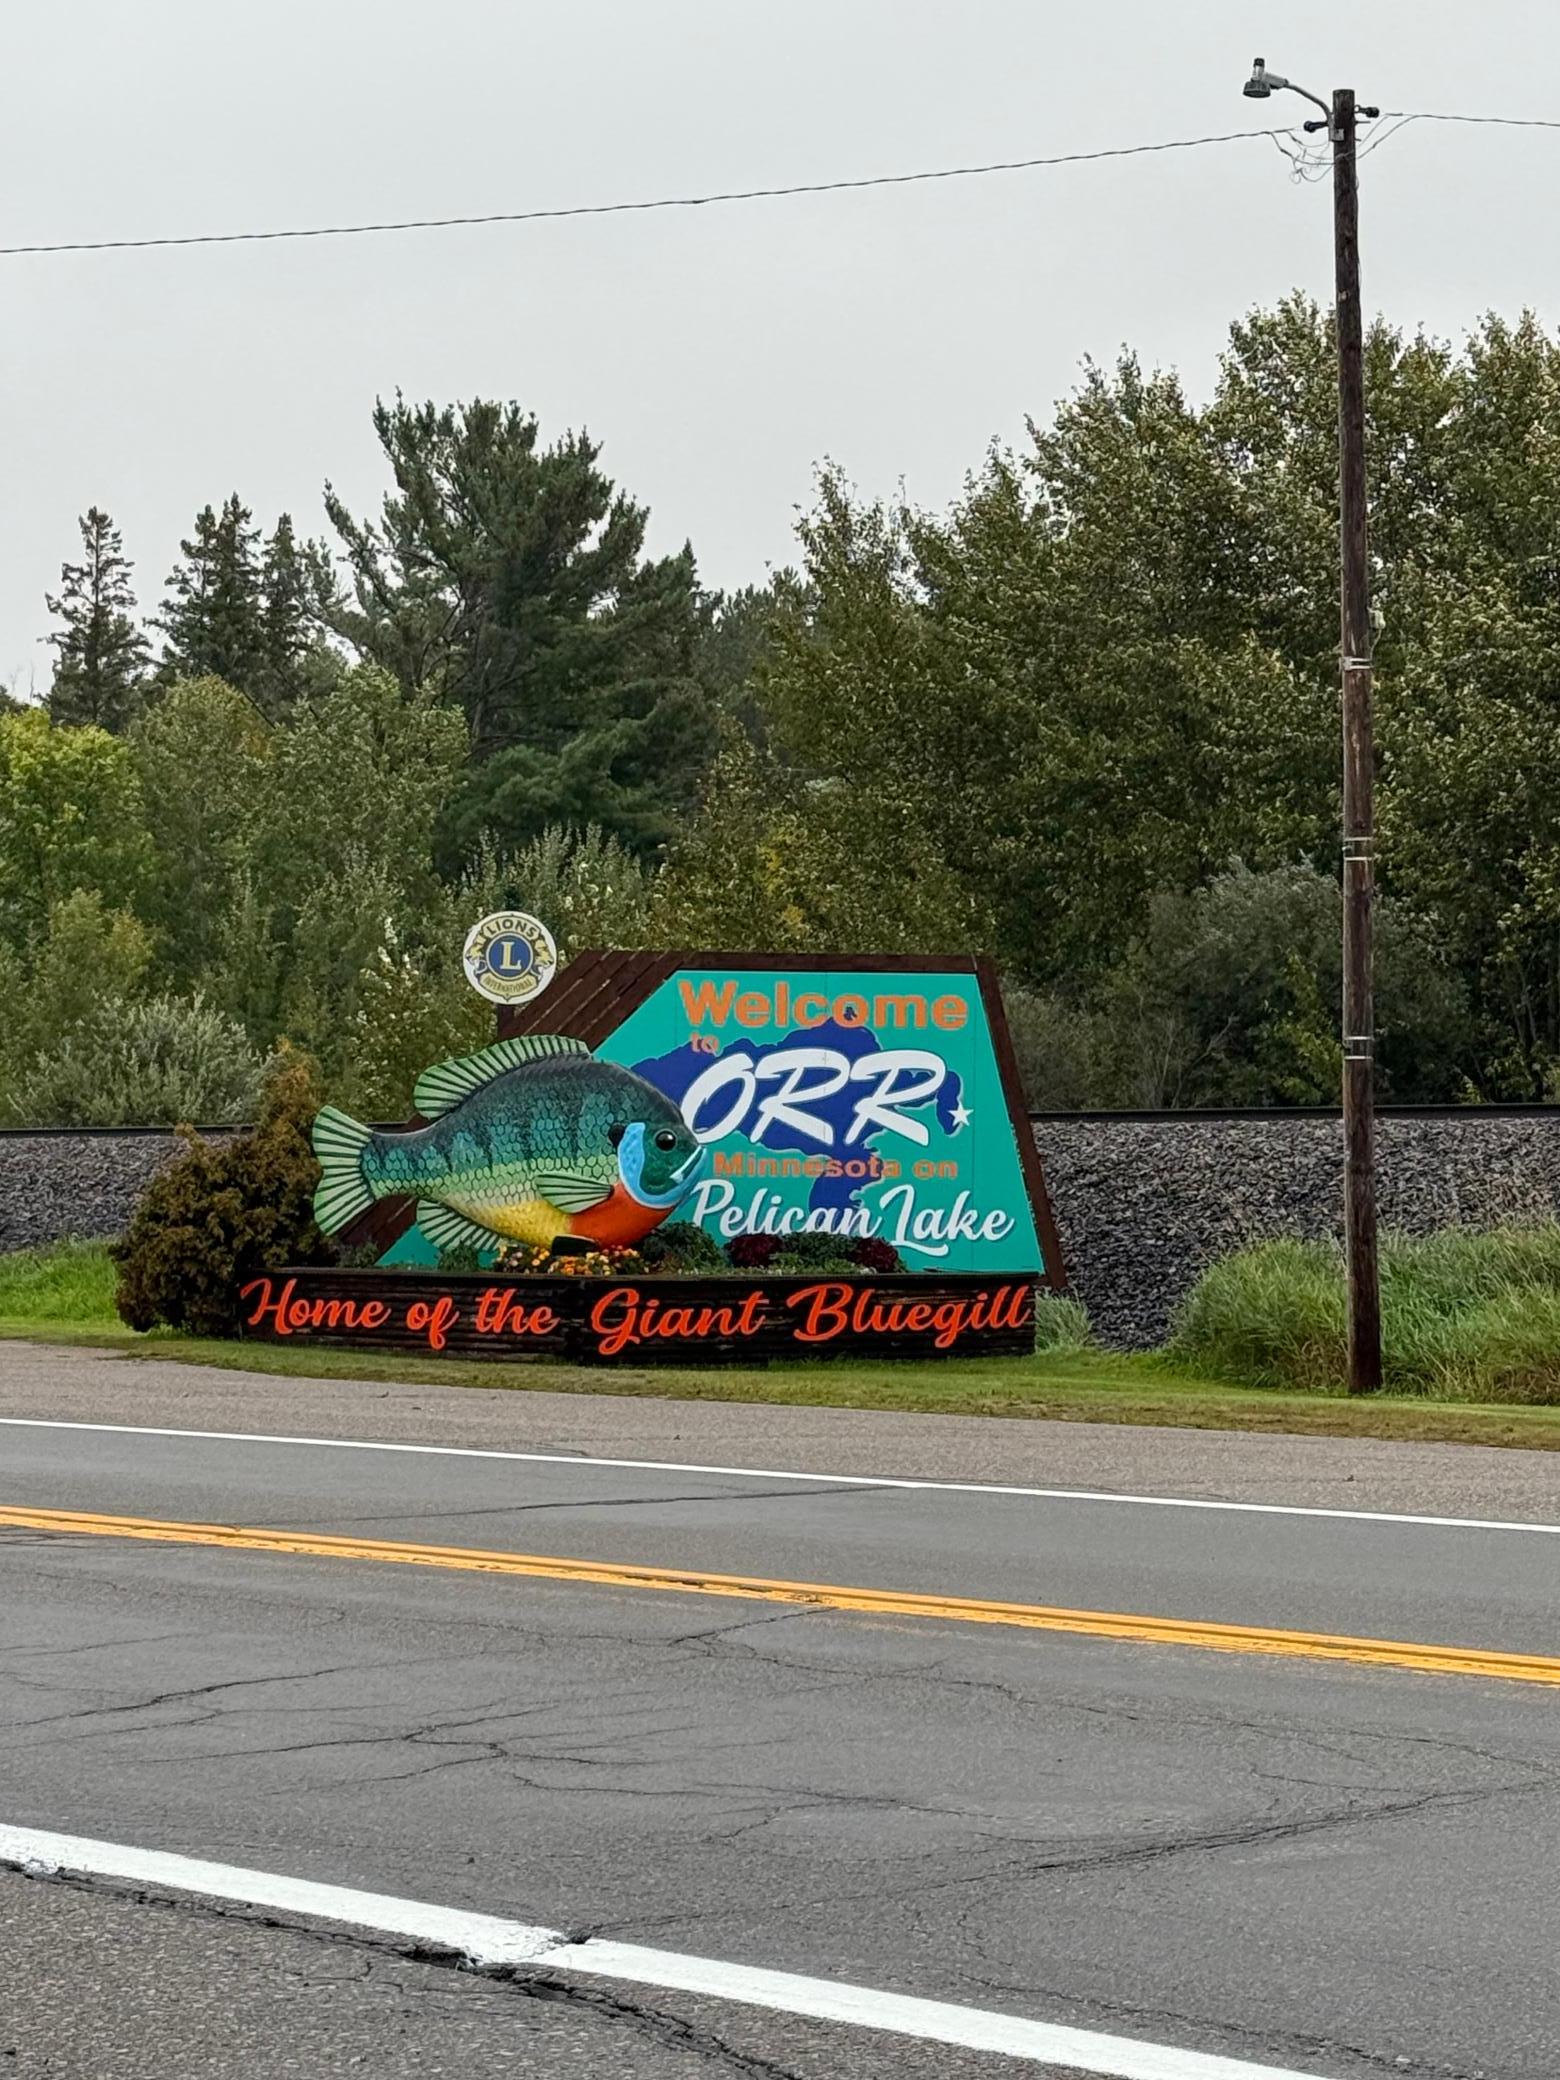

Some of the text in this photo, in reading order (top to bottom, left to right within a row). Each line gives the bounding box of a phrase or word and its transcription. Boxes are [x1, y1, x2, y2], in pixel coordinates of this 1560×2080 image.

[486, 919, 537, 938] LIONS
[499, 941, 522, 970] L
[678, 979, 969, 1030] Welcome
[691, 1032, 721, 1054] to
[680, 1048, 946, 1146] ORR
[713, 1152, 958, 1180] Minnesota on
[691, 1179, 1015, 1256] Pelican Lake
[239, 1277, 1031, 1355] Home of the Giant Bluegill
